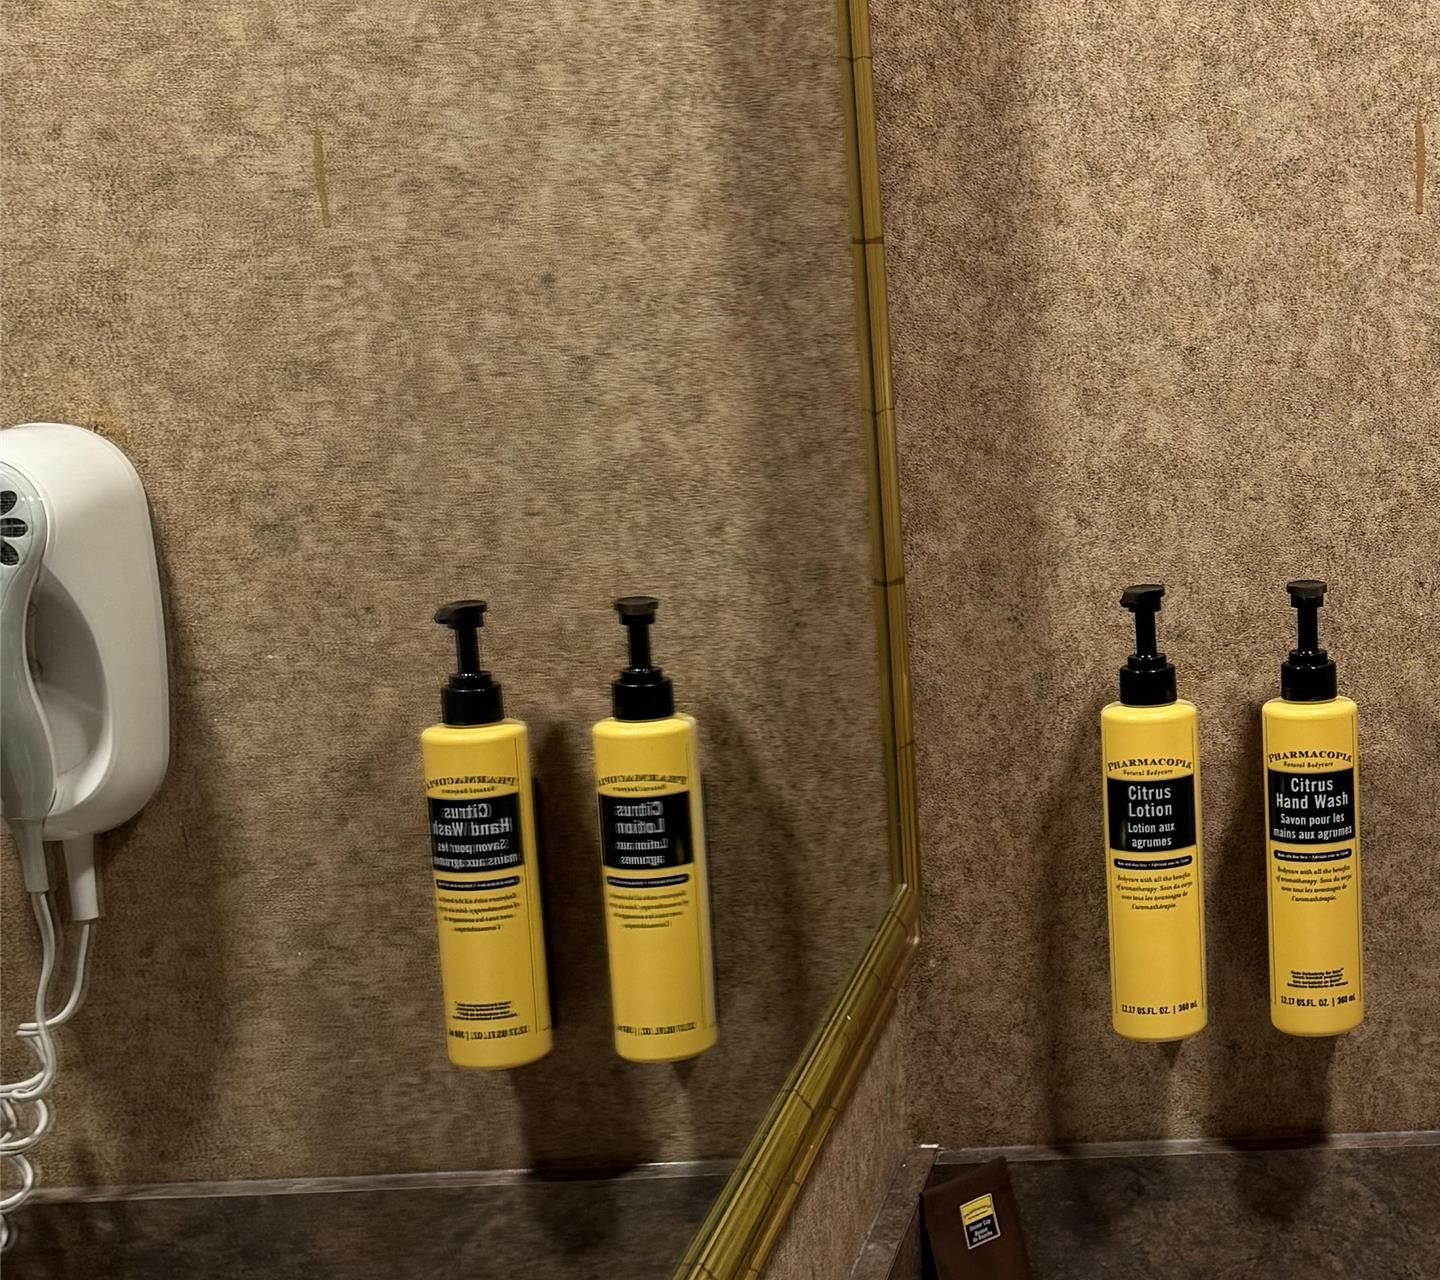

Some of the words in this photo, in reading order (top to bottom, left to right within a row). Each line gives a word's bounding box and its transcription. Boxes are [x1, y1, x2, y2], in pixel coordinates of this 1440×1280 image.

[1268, 751, 1353, 763] PHARMACOPIA
[1108, 758, 1192, 772] PHARMACOPIA
[1128, 785, 1171, 800] Citrus
[1291, 778, 1334, 793] Citrus
[1276, 793, 1309, 809] Hand
[1314, 792, 1349, 809] Wash
[1128, 802, 1172, 817] Lotion
[1280, 814, 1306, 825] Savon
[1309, 816, 1331, 828] pour
[1333, 812, 1345, 824] les
[1128, 822, 1156, 833] Lotion
[1158, 823, 1175, 832] aux
[1273, 828, 1296, 839] mains
[1299, 831, 1316, 839] aux
[1317, 826, 1353, 840] agrumes
[1131, 837, 1172, 849] agrumes
